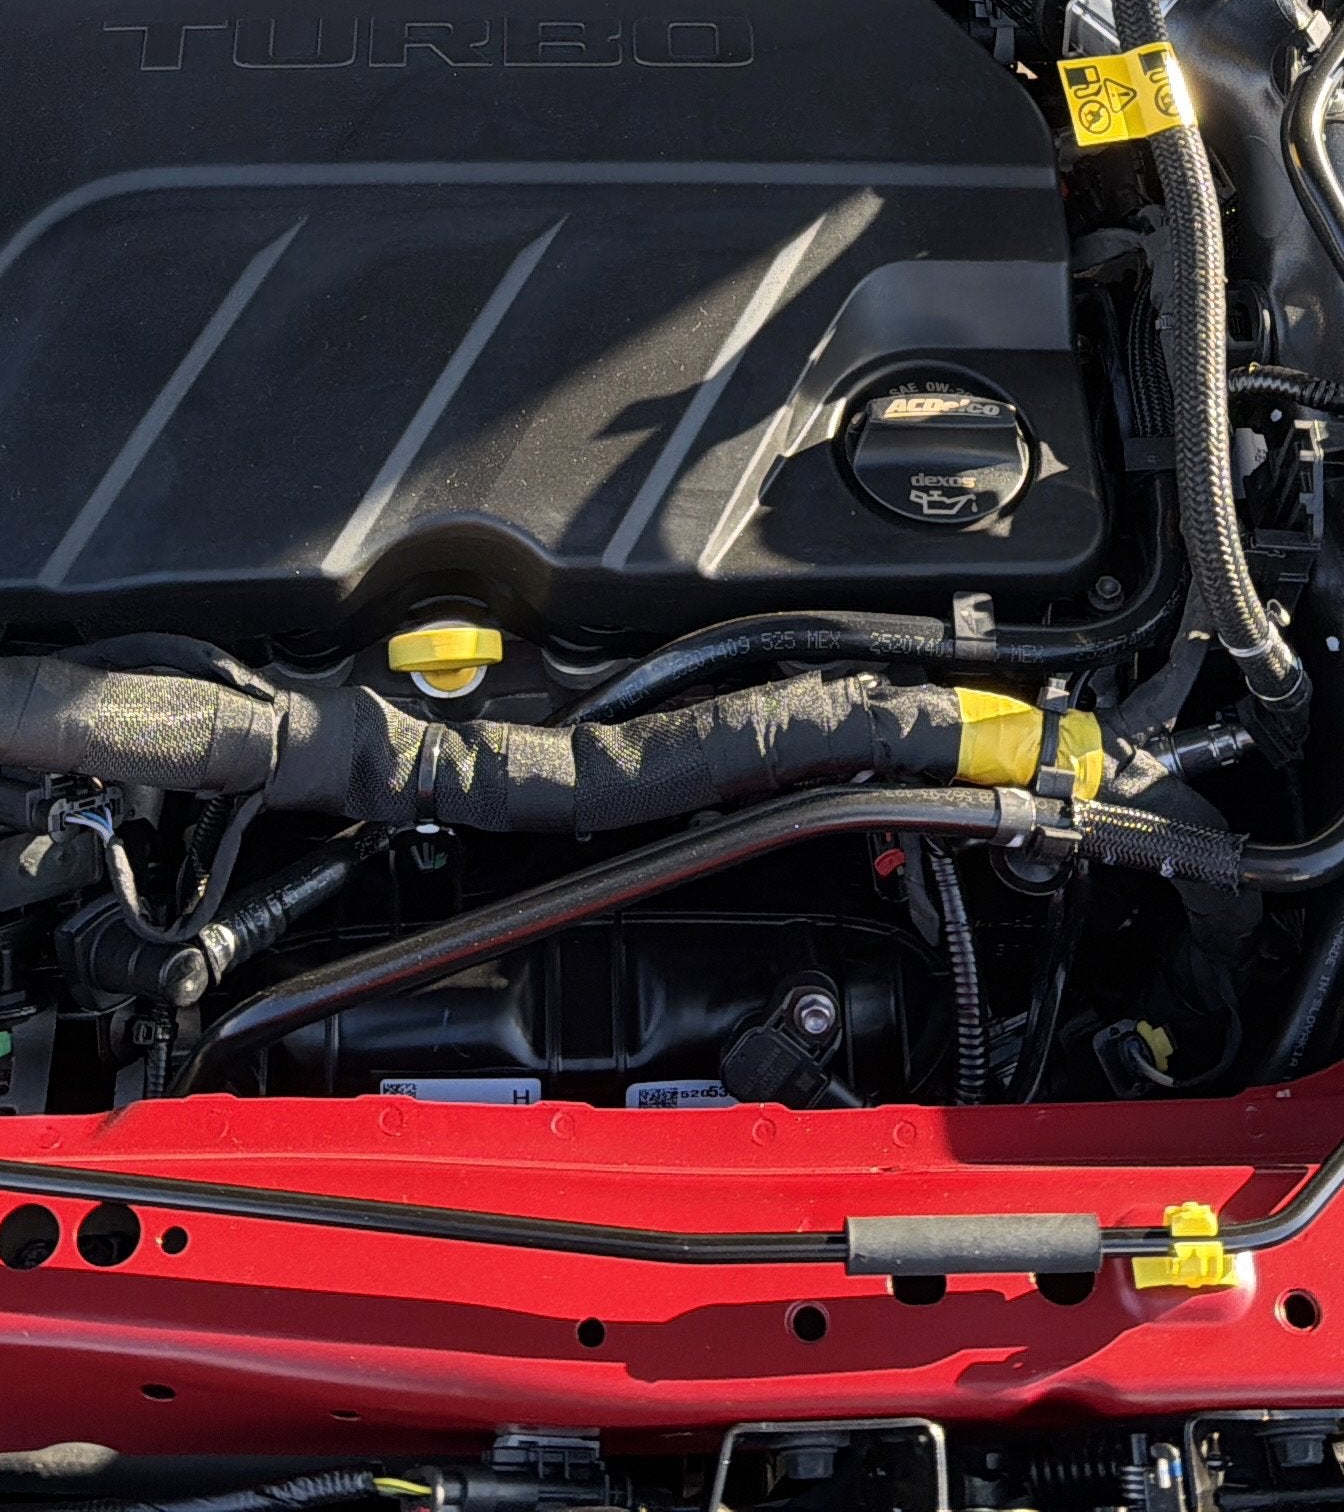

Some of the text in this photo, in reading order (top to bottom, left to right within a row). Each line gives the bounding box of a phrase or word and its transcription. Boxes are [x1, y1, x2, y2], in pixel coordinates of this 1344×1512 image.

[103, 14, 755, 72] TURBO
[925, 380, 973, 397] 0W-2
[885, 398, 1000, 416] ACDelco
[910, 472, 977, 488] dexos
[761, 631, 796, 651] 525
[807, 630, 841, 650] MEX
[513, 1089, 531, 1105] H
